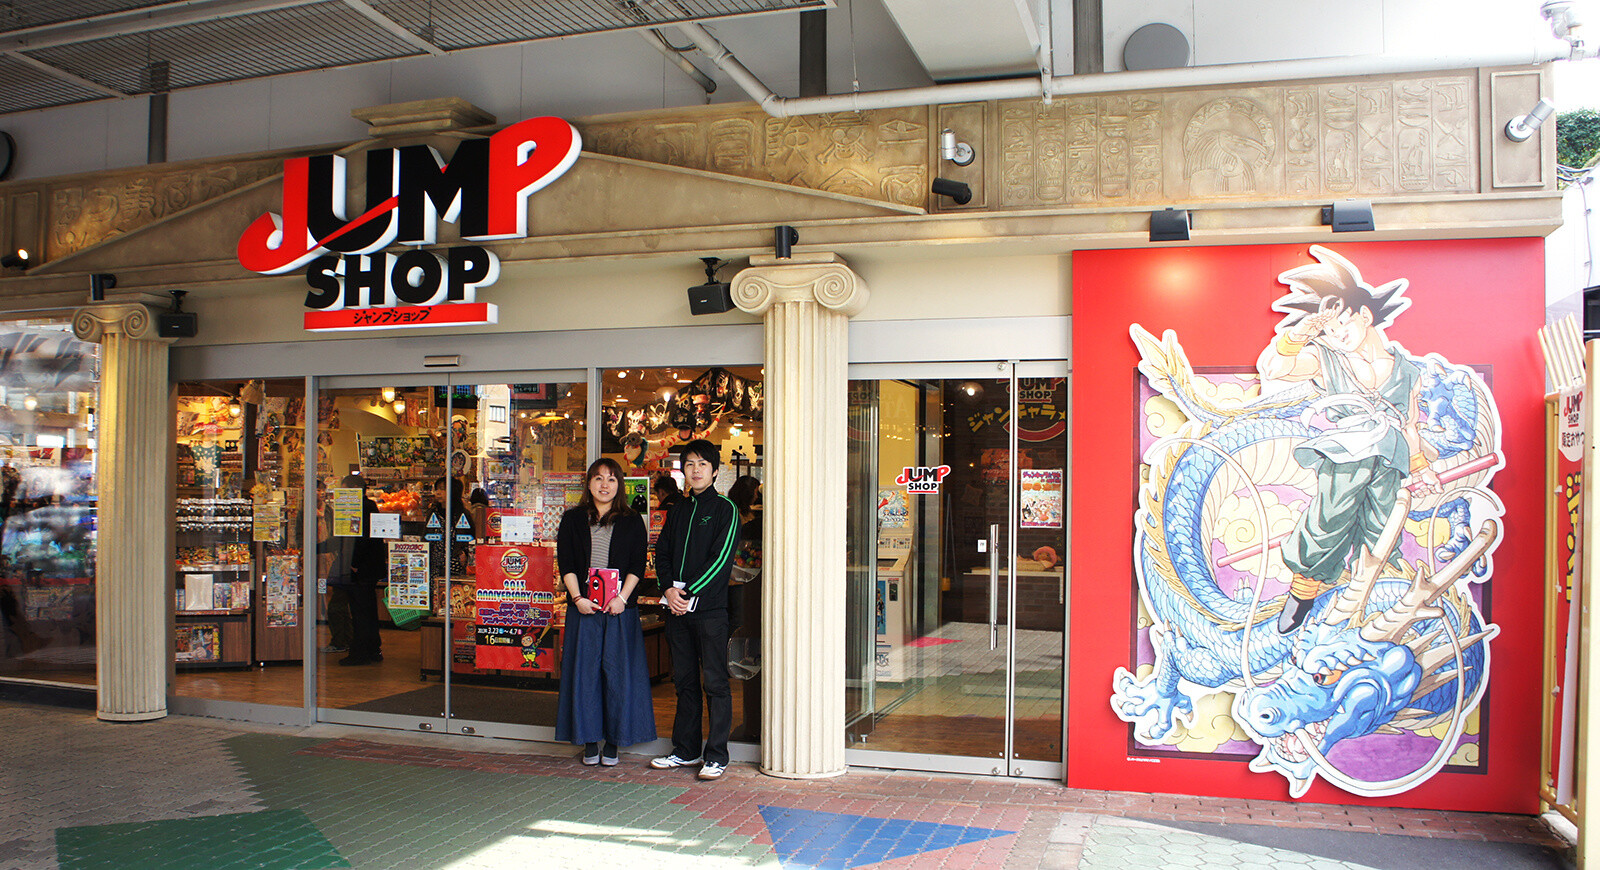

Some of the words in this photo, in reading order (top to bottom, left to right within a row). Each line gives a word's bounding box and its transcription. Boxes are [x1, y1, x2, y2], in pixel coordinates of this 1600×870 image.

[237, 116, 580, 273] JUMP
[304, 246, 499, 310] SHOP
[353, 306, 433, 324] ジャンプショップ
[1019, 391, 1052, 399] SHOP
[1564, 391, 1584, 417] JUMP
[896, 466, 950, 484] JUMP
[908, 482, 938, 491] SHOP
[501, 556, 528, 567] JUMP
[476, 589, 533, 603] ANNIVERSARY
[532, 591, 554, 604] FAIR
